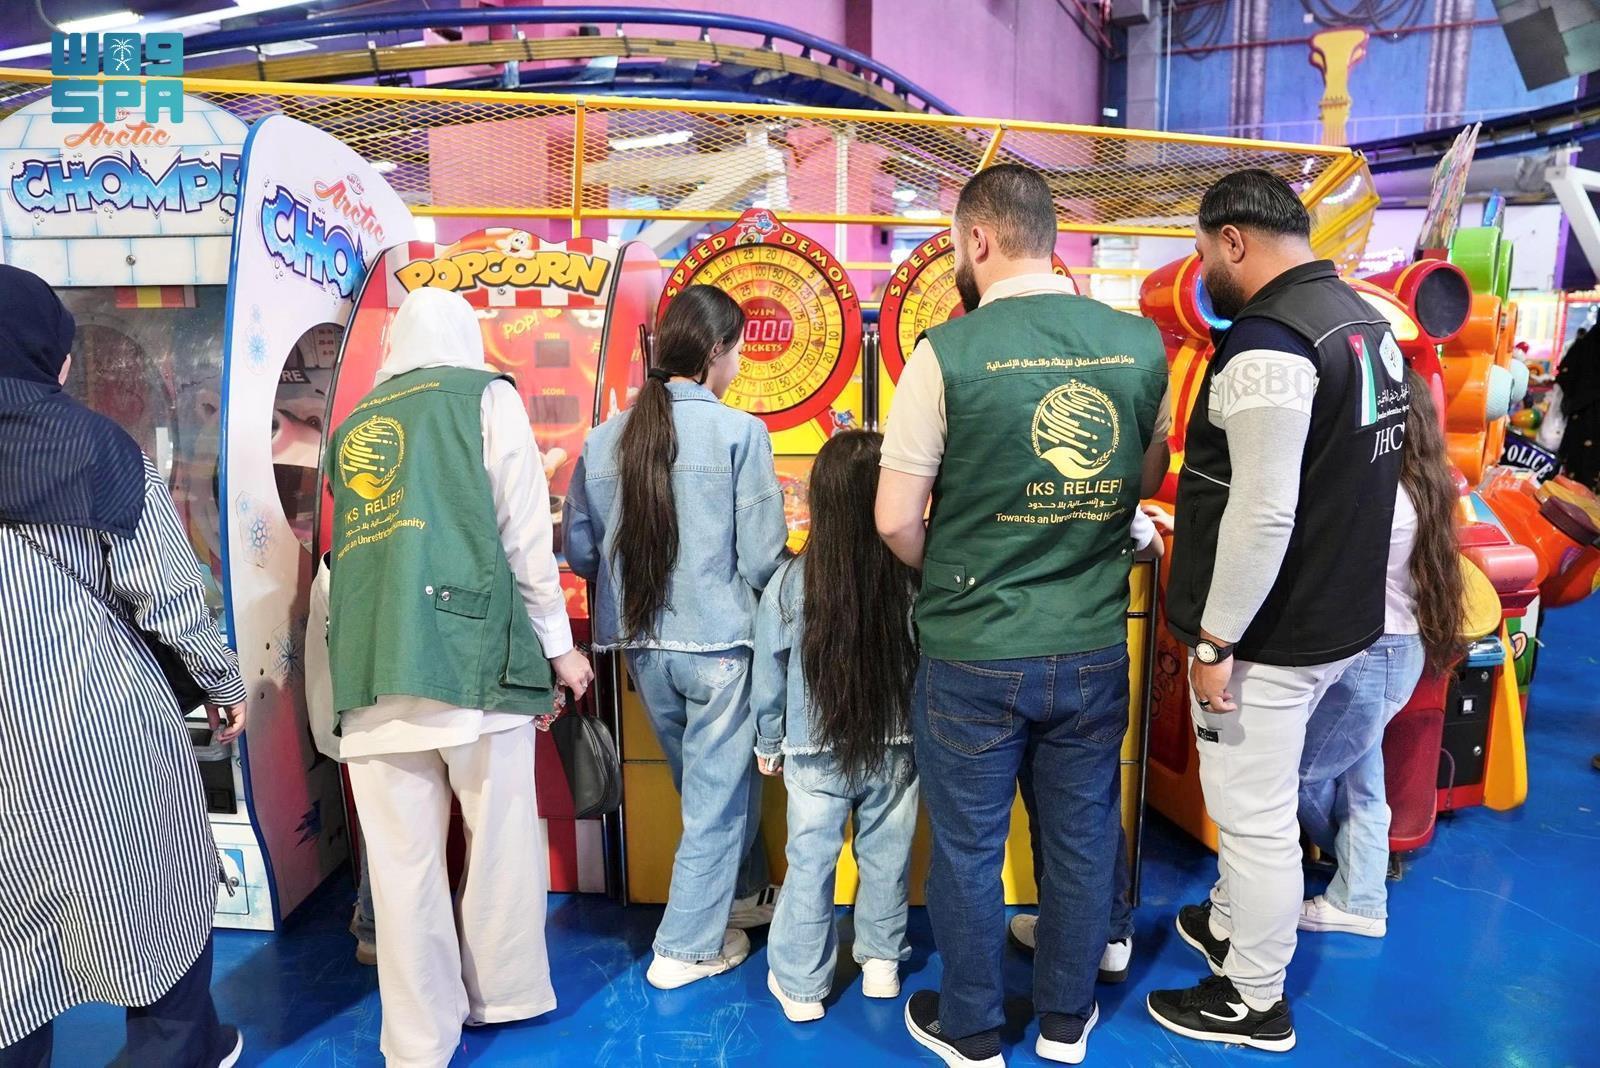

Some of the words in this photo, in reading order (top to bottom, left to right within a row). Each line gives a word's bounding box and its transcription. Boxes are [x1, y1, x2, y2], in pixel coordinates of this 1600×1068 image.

[63, 120, 171, 148] Arctic
[314, 179, 386, 244] Arctic
[261, 184, 368, 300] CHO
[721, 255, 733, 267] 10
[743, 249, 754, 260] 25
[766, 249, 777, 260] 20
[666, 236, 727, 297] SPEED
[780, 231, 853, 300] DEMON
[772, 267, 783, 279] 50
[890, 235, 951, 297] SPEED
[395, 251, 612, 297] POPCORN
[704, 269, 713, 279] 5
[787, 274, 799, 288] 75
[748, 308, 776, 317] WIN
[741, 343, 783, 353] TICKETS
[1502, 444, 1554, 479] OLICE
[1026, 481, 1055, 497] (KS
[1063, 478, 1123, 496] RELIEF)
[365, 486, 404, 516] RELIEF)
[996, 512, 1036, 524] Towards
[1037, 515, 1049, 524] an
